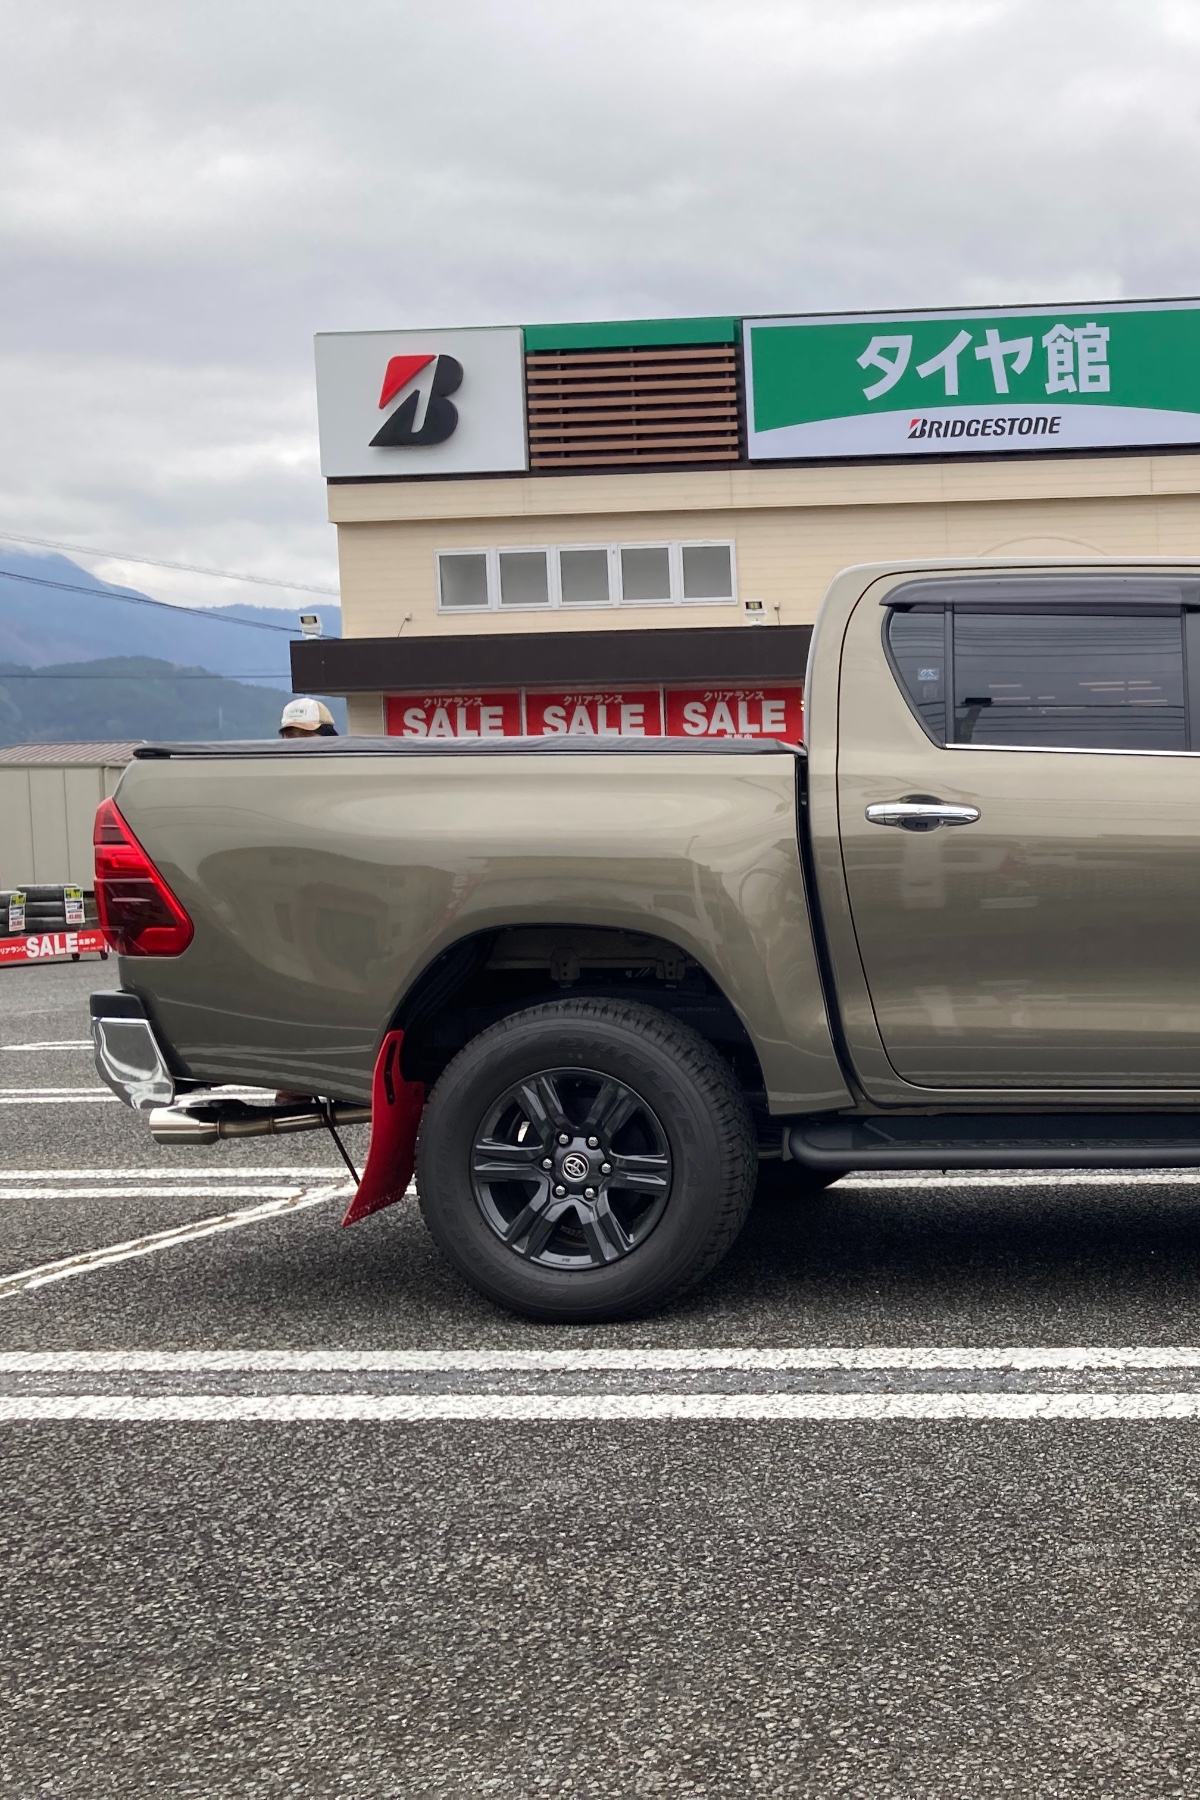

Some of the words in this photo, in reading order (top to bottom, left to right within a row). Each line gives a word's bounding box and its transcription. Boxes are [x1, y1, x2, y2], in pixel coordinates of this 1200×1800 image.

[856, 322, 1110, 400] タイヤ館
[907, 416, 1062, 439] BRIDGESTONE
[423, 696, 484, 708] クリアランス
[563, 694, 624, 706] クリアランス
[703, 690, 766, 702] クリアランス
[402, 705, 505, 738] SALE
[542, 703, 646, 737] SALE
[682, 700, 787, 736] SALE
[26, 932, 79, 958] SALE
